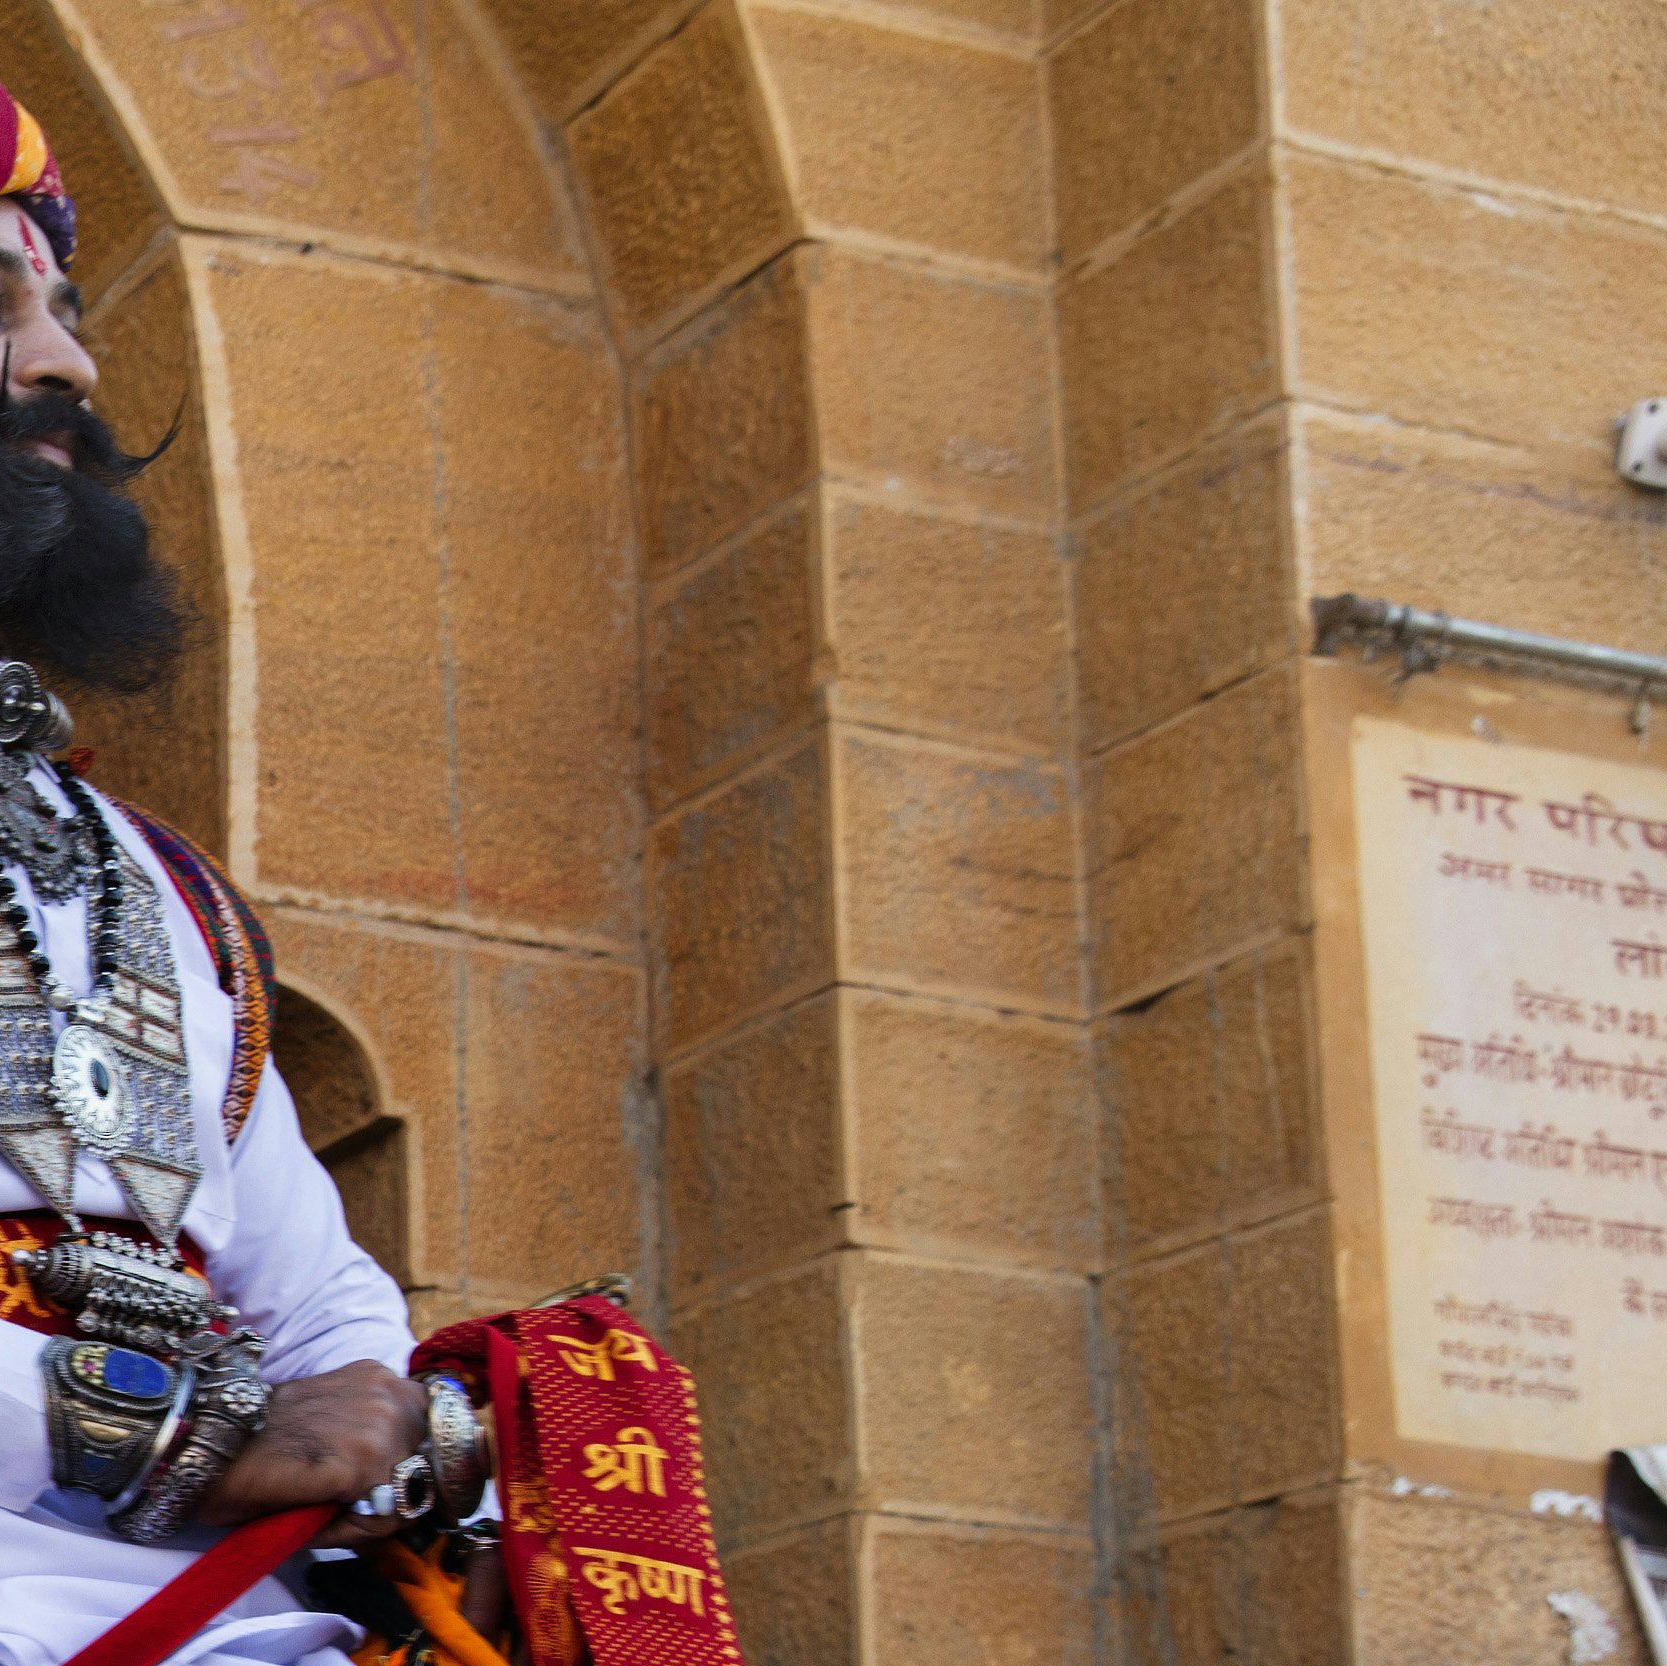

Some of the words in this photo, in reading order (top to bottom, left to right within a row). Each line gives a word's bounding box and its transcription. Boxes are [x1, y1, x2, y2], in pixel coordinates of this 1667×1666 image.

[1402, 774, 1520, 832] नगर
[580, 1426, 670, 1498] श्री
[571, 1546, 707, 1617] कृष्ण
